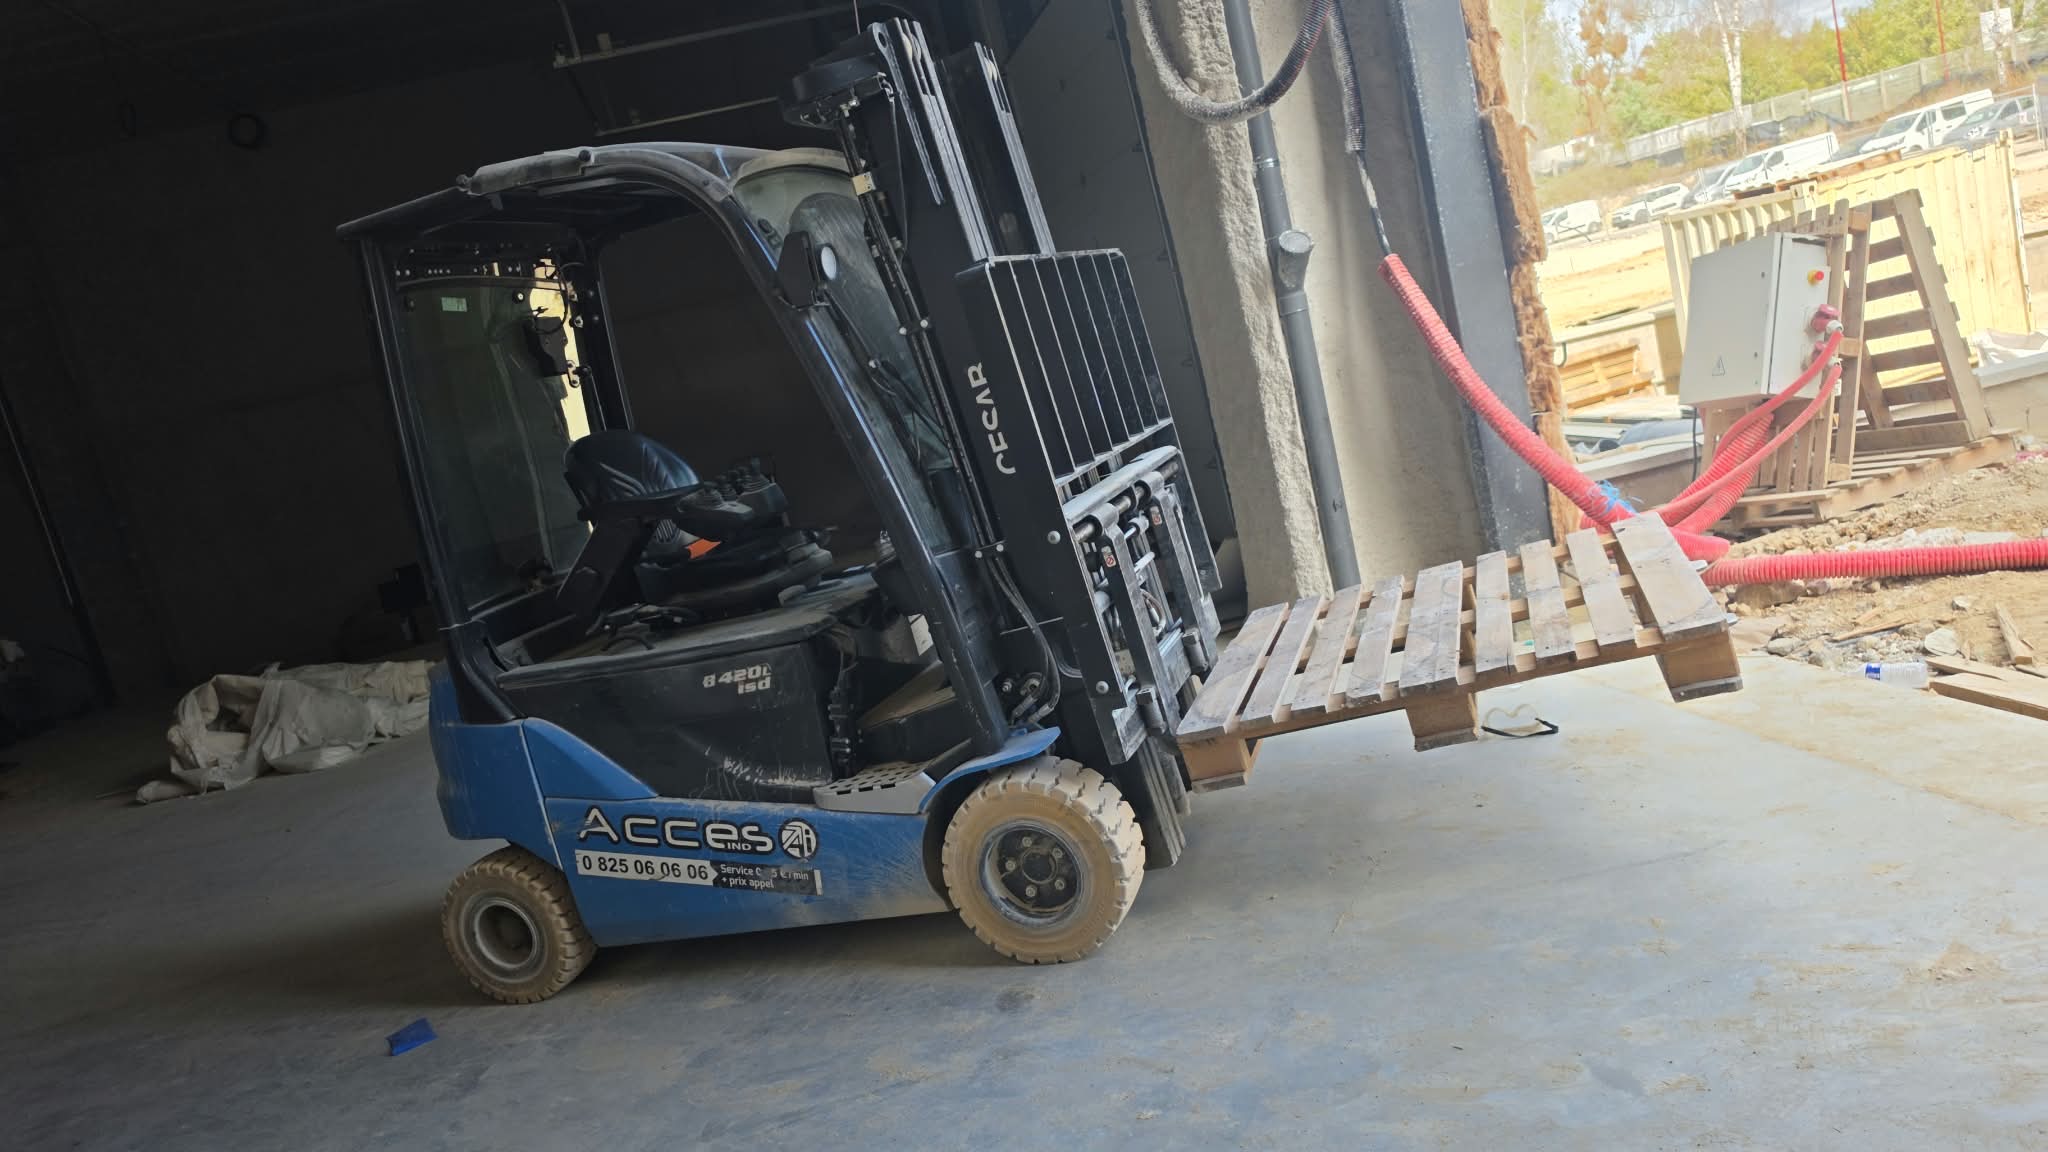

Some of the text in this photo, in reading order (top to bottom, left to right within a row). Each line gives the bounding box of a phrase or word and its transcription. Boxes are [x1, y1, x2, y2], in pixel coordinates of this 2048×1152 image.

[577, 806, 775, 854] Acces
[727, 842, 752, 851] IND
[582, 855, 708, 880] 0 825 06 06 06
[720, 864, 754, 876] Service
[729, 876, 747, 887] prix
[749, 879, 775, 890] appel
